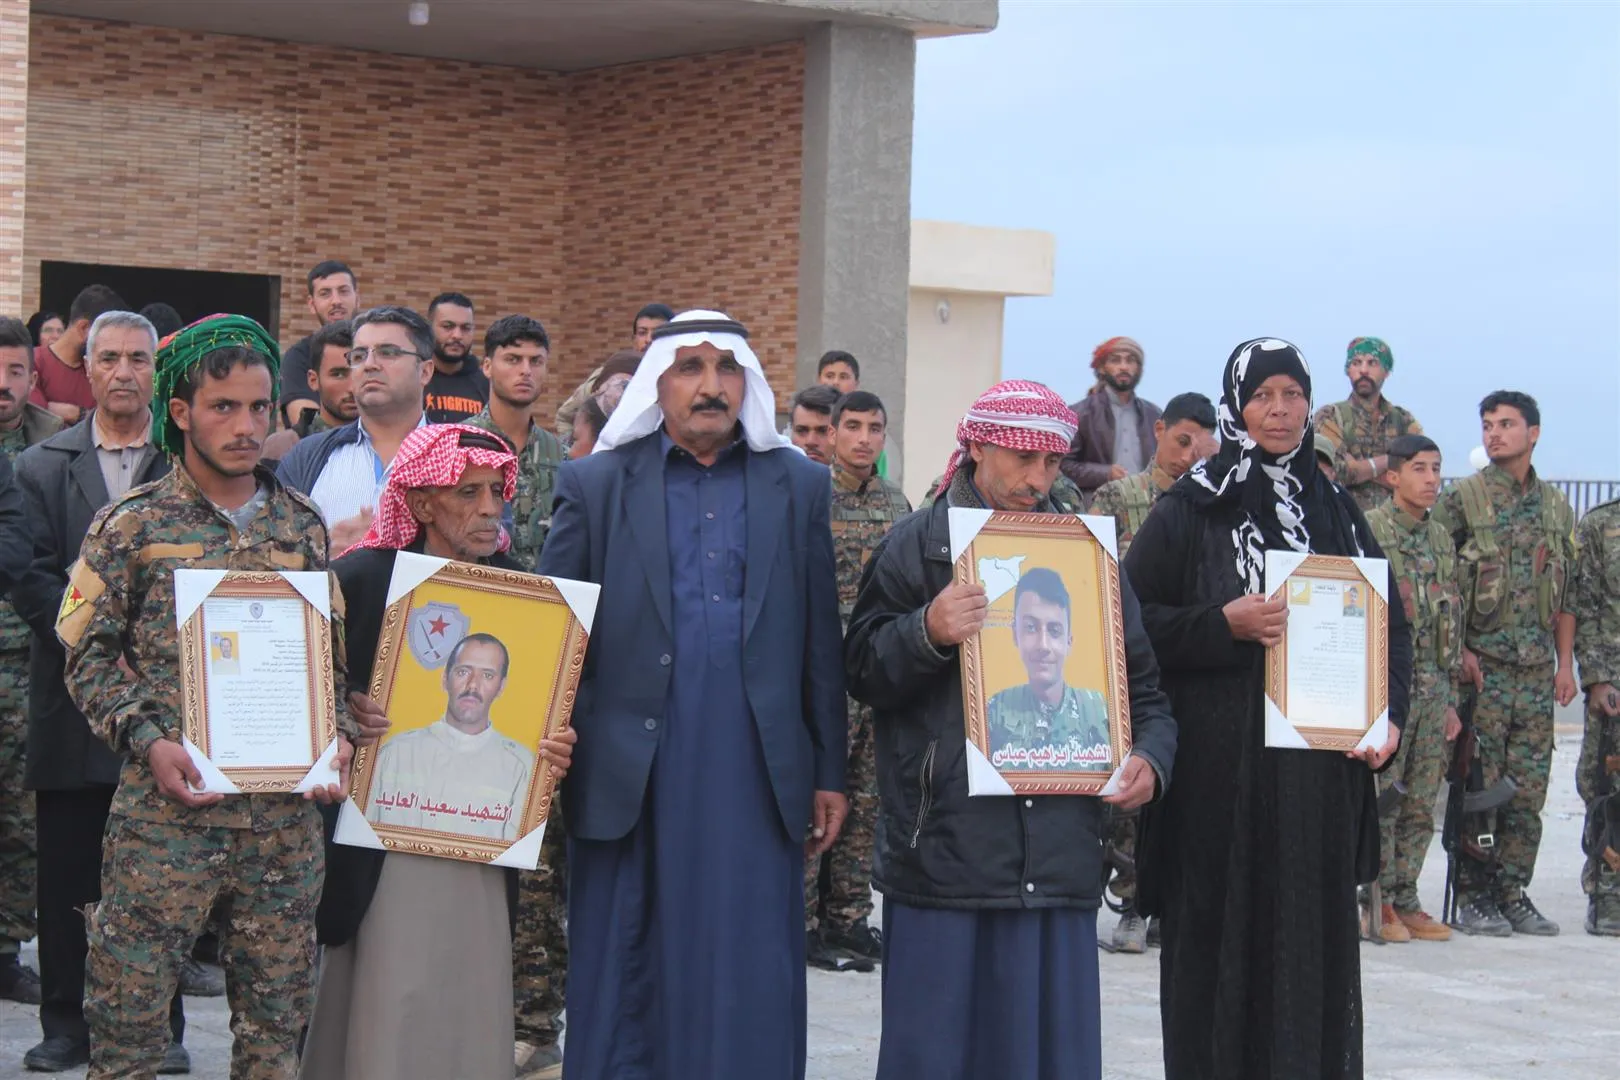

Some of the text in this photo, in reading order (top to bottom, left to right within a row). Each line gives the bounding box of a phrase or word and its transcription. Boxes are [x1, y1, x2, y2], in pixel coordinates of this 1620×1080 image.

[993, 743, 1111, 768] الشهيد ابراهيم عباس
[375, 790, 513, 823] الشهيد سعيد العايد
